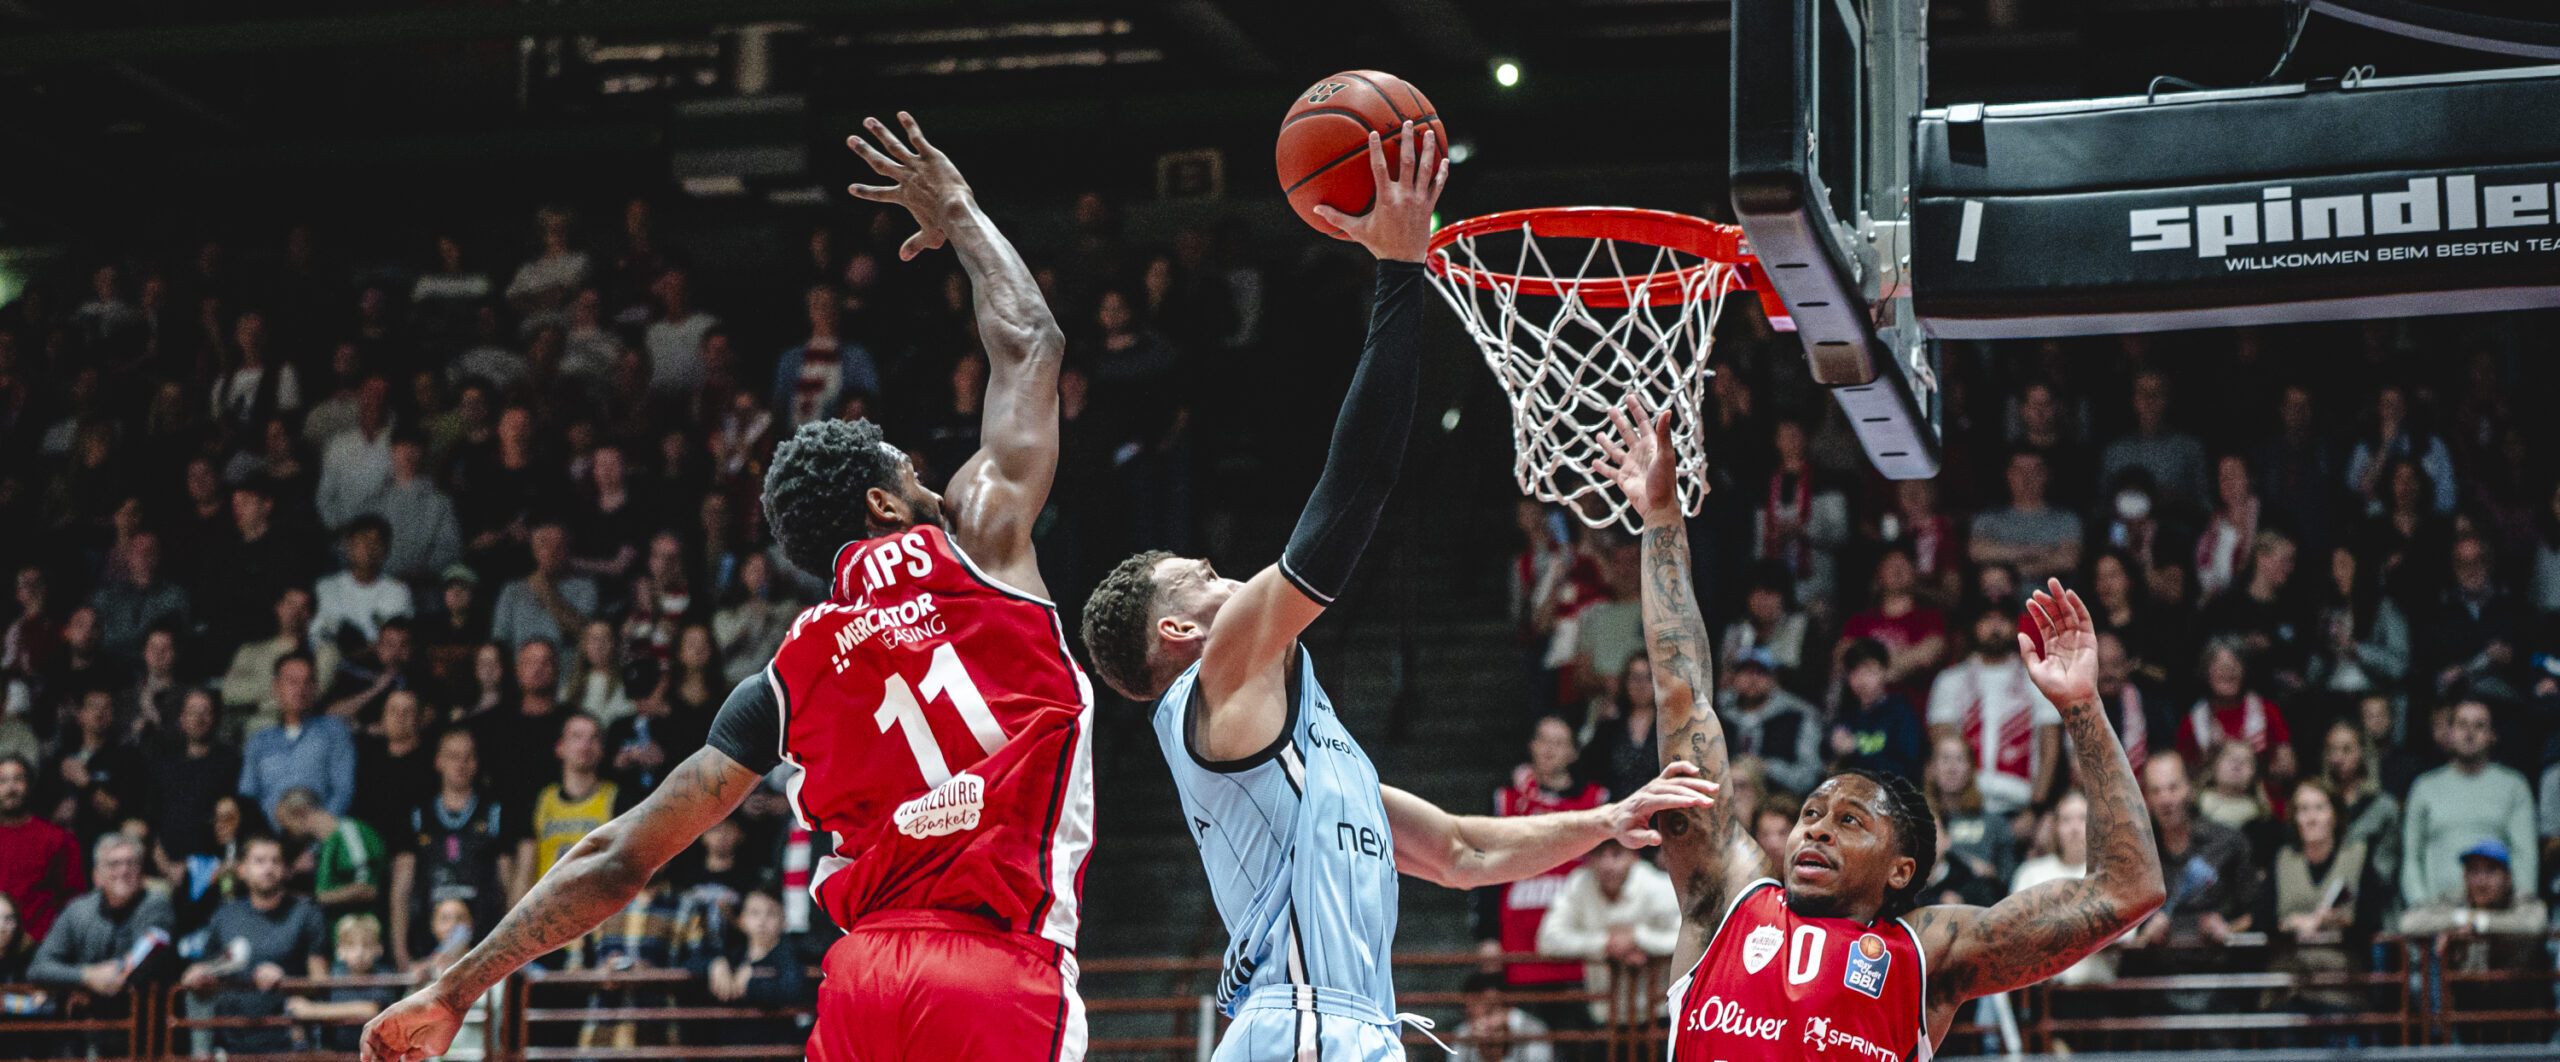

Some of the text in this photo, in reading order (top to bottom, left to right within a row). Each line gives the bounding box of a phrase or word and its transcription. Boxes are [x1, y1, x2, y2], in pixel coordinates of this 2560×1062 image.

[2130, 174, 2560, 258] spindle
[2225, 249, 2369, 272] WILLKOMMEN
[2377, 246, 2429, 262] BEIM
[2437, 240, 2519, 258] BESTEN
[834, 592, 936, 655] MERCATOR
[873, 641, 1010, 790] 11
[904, 809, 977, 835] Baskets
[1788, 924, 1826, 985] 0
[1849, 970, 1877, 993] BBL
[1687, 996, 1788, 1041] s.Oliver
